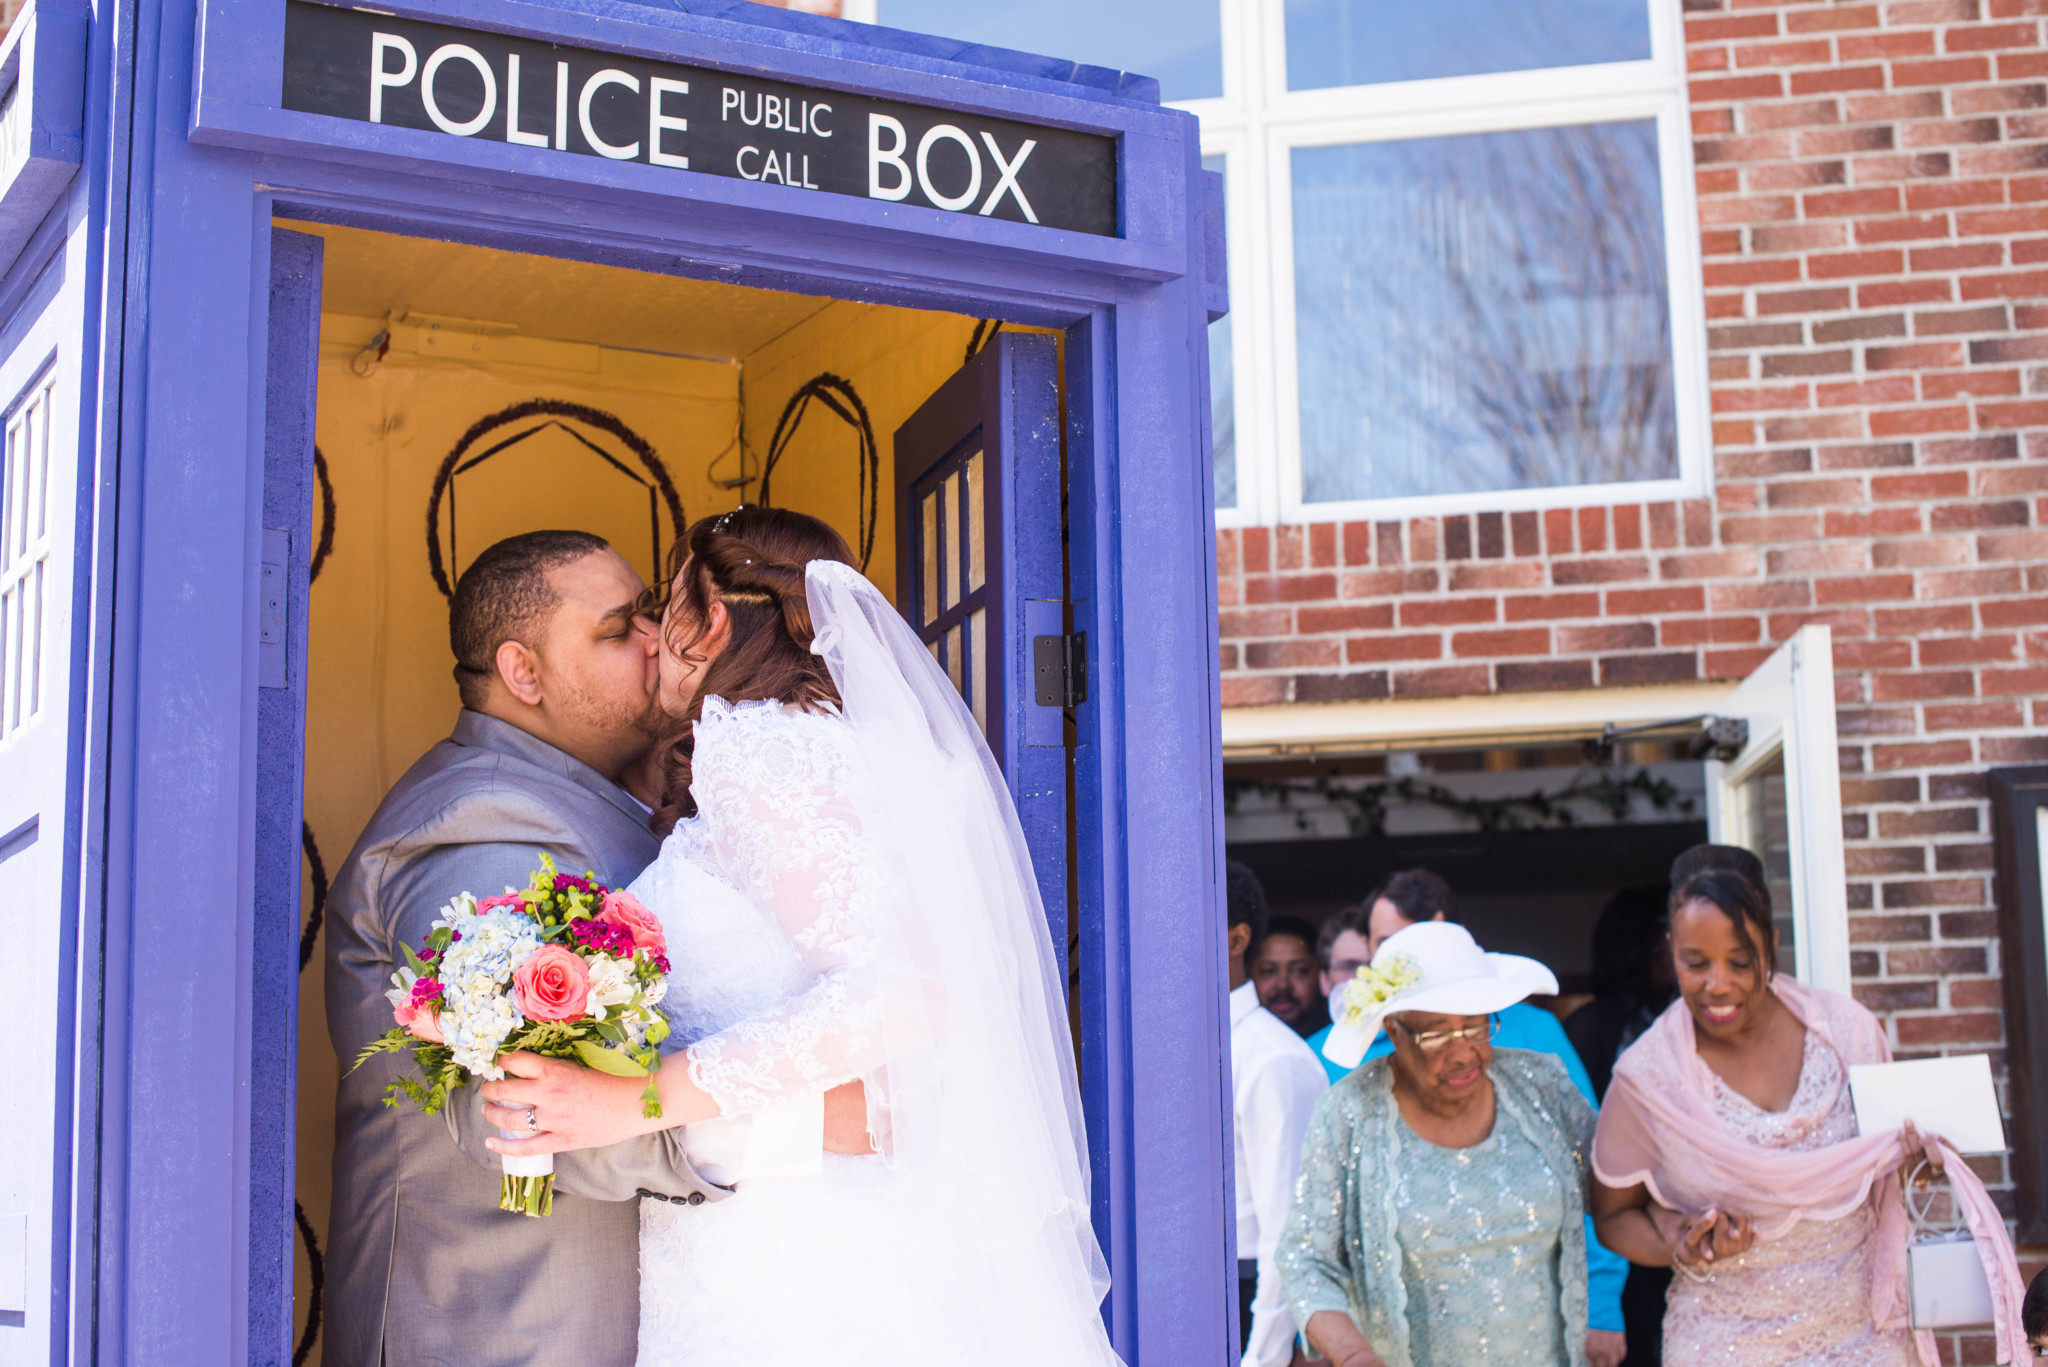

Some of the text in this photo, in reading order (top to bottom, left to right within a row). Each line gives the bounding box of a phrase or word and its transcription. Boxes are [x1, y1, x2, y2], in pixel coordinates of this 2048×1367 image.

[369, 31, 690, 169] POLICE
[722, 87, 833, 138] PUBLIC
[736, 145, 819, 190] CALL
[868, 112, 1040, 224] BOX
